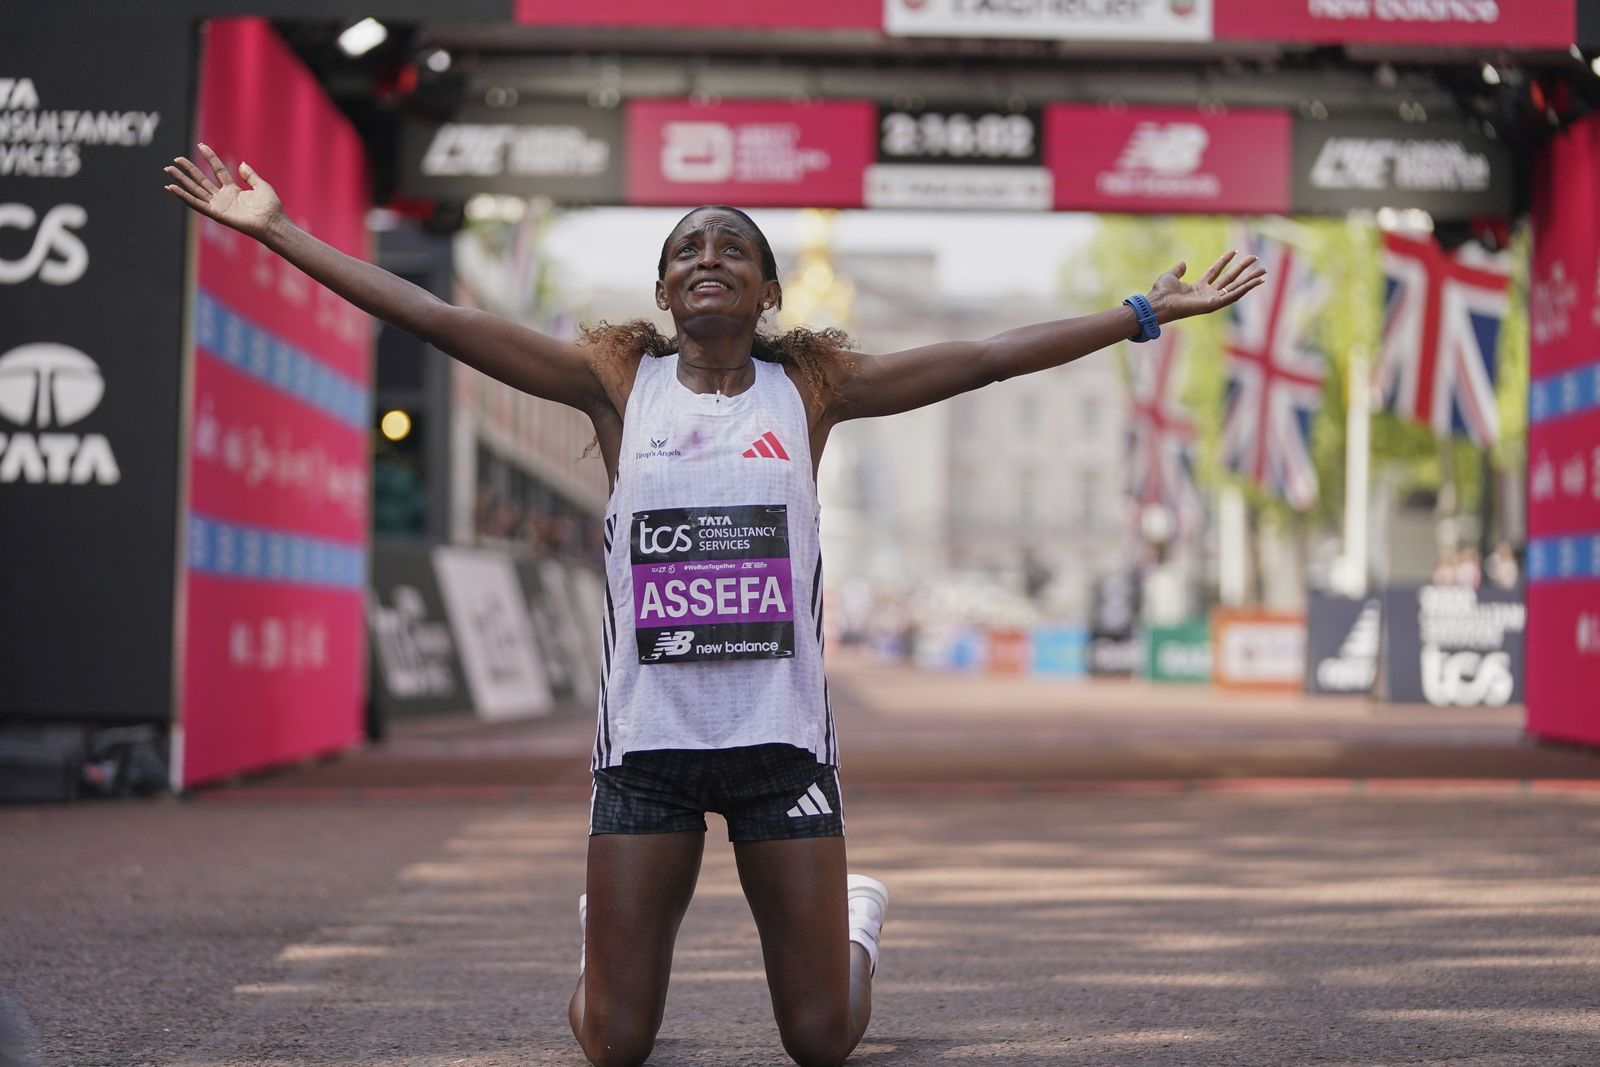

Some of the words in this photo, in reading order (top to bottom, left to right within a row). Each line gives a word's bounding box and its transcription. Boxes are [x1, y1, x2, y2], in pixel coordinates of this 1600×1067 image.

[698, 516, 732, 526] TATA
[698, 527, 776, 539] CONSULTANCY
[699, 540, 750, 551] SERVICES
[684, 563, 736, 571] #WeRunTogether
[640, 576, 786, 620] ASSEFA
[696, 644, 722, 654] new
[725, 640, 778, 653] balance
